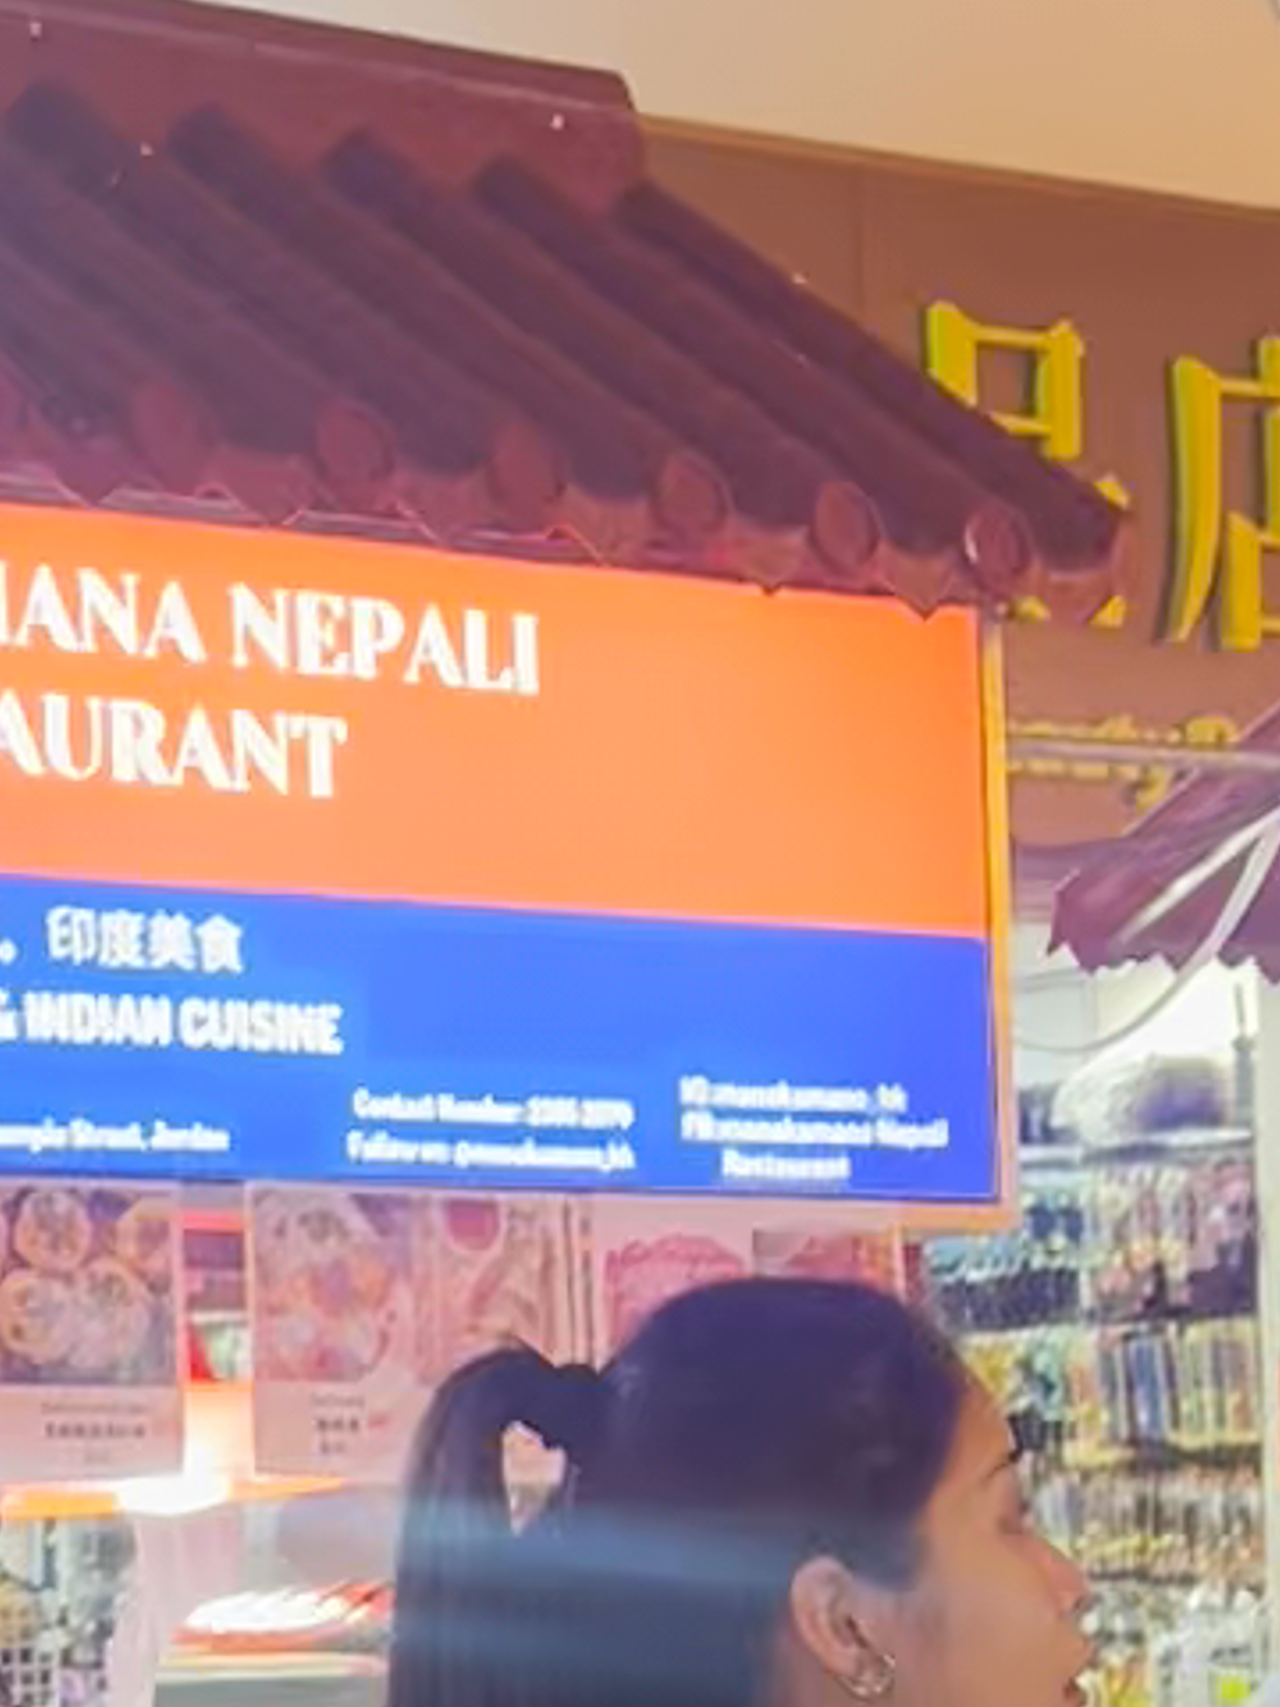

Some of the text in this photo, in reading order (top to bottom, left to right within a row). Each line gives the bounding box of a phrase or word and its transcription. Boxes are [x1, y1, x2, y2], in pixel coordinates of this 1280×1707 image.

[227, 581, 540, 696] NEPALI
[22, 991, 172, 1047] INDIAN
[178, 999, 344, 1054] CUISINE
